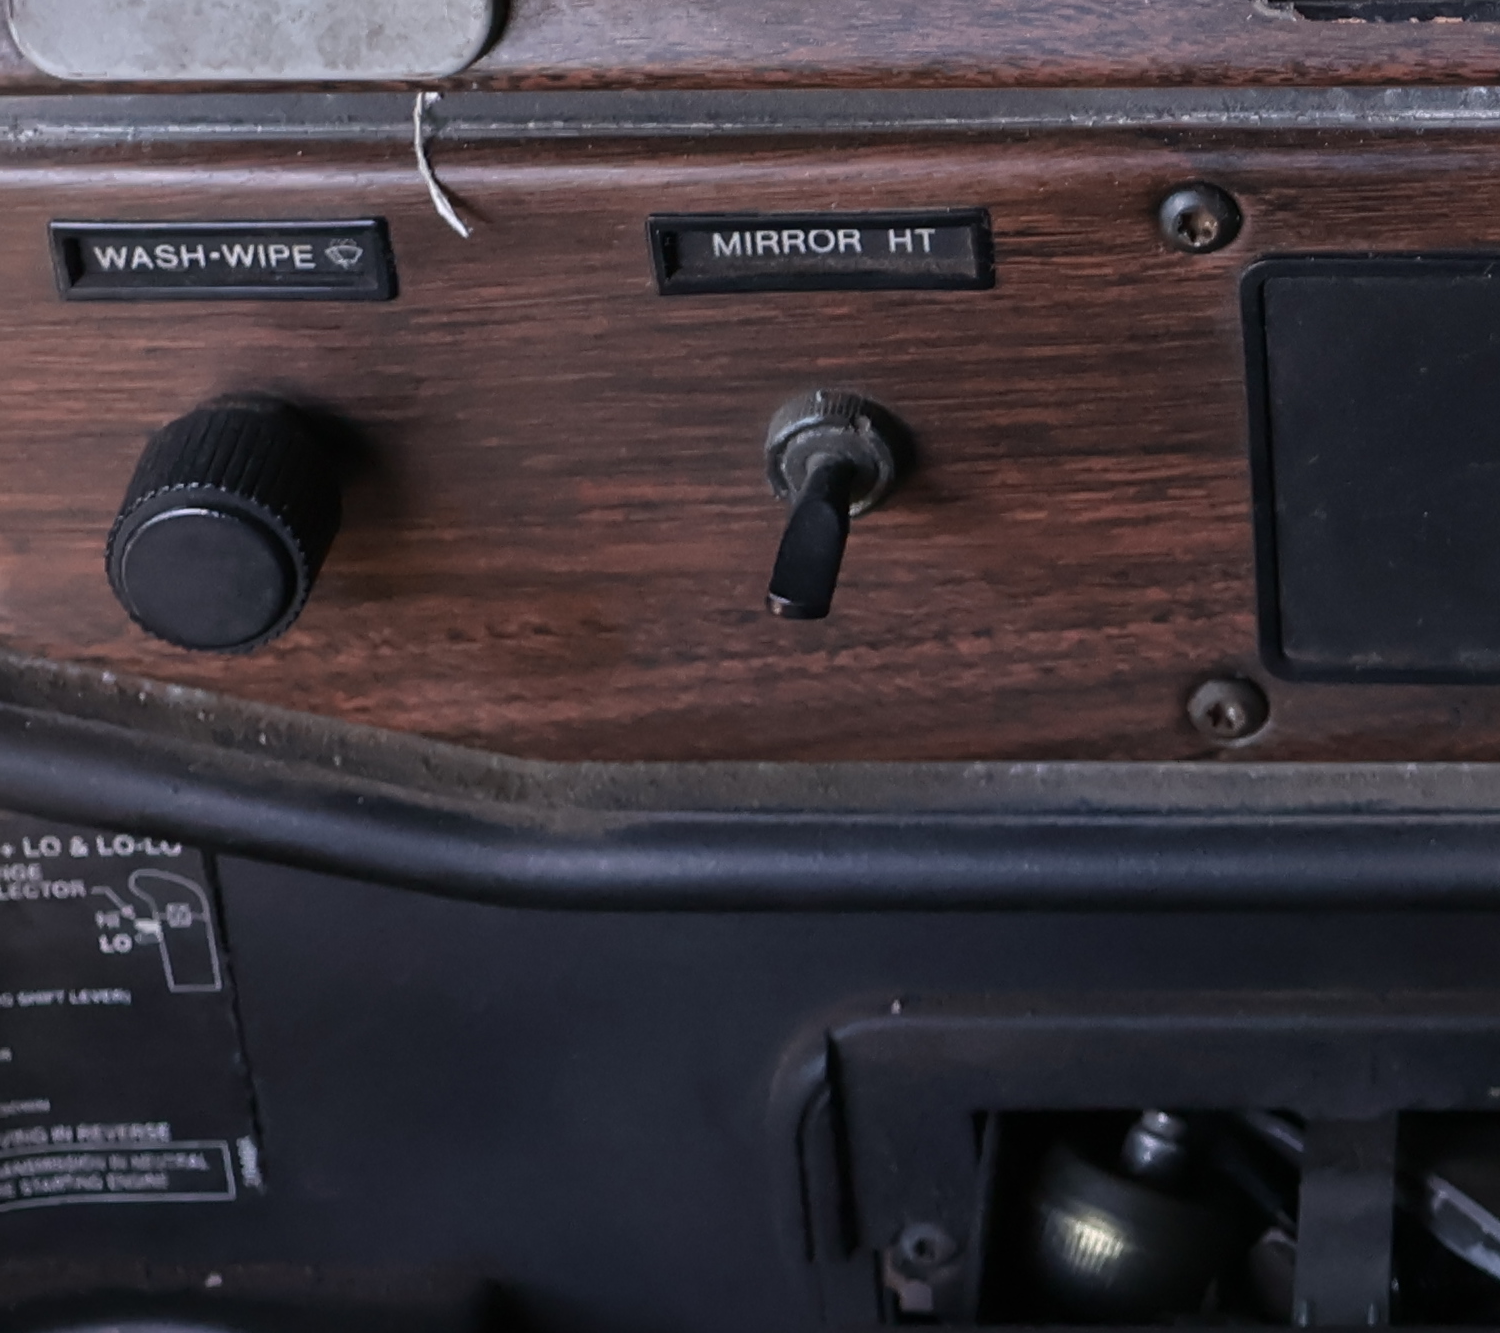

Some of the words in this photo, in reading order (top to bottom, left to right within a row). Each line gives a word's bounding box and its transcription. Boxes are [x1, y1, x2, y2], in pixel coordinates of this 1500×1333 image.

[713, 229, 861, 257] MIRROR
[889, 227, 935, 254] HT
[94, 243, 316, 271] WASH-WIPE
[22, 834, 63, 858] LO
[69, 835, 90, 858] &
[98, 933, 133, 954] LO
